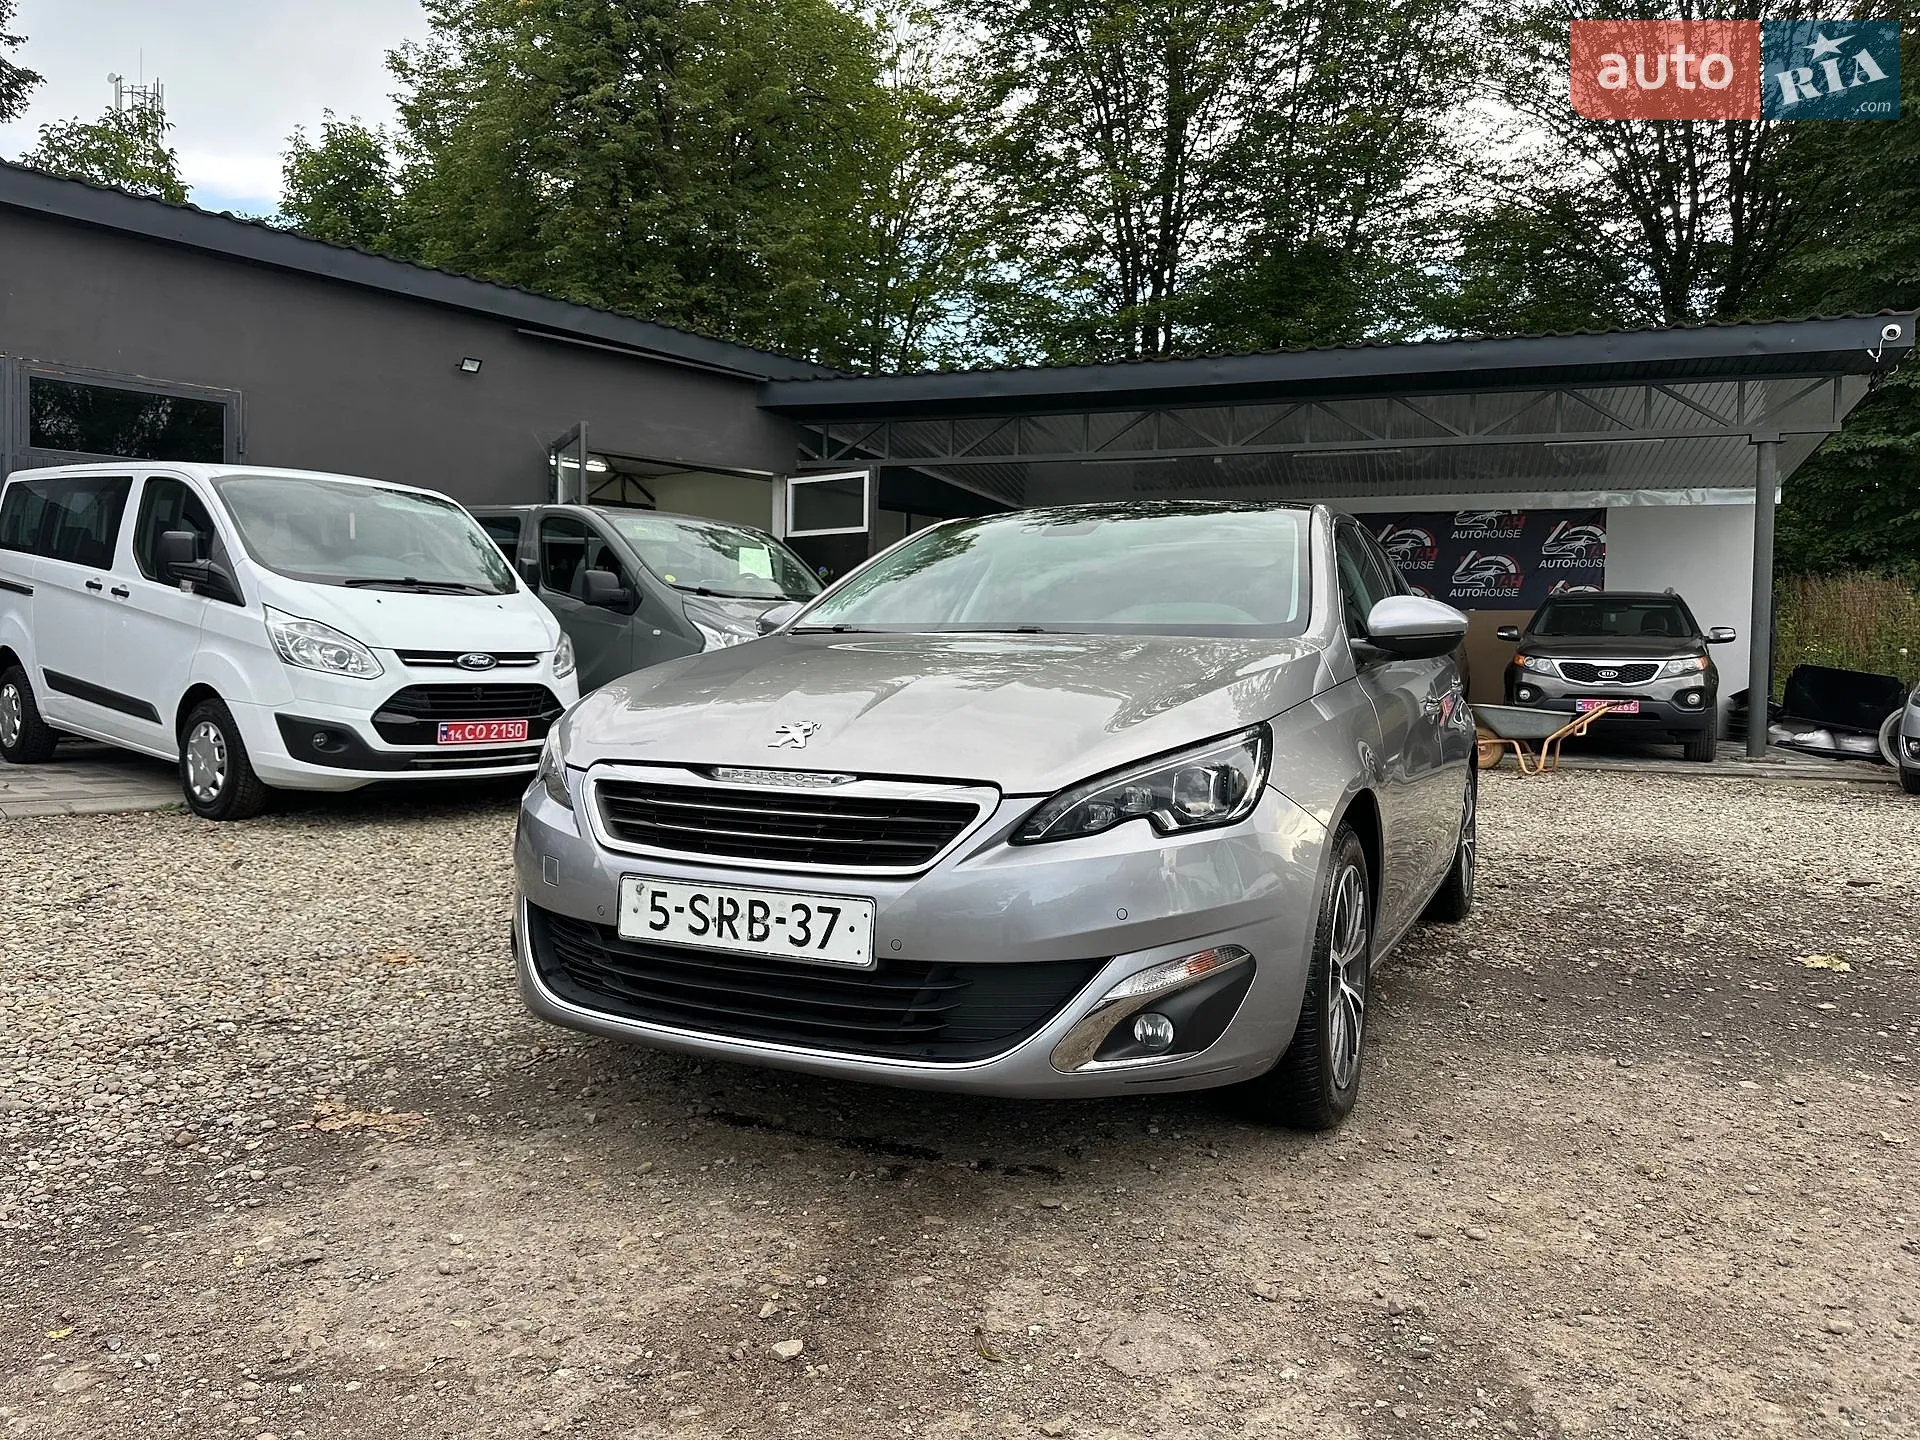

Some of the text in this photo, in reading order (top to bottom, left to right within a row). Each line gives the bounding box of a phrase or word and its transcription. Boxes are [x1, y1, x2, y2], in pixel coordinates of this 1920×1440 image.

[1450, 529, 1522, 539] AUTOHOUSE
[1448, 587, 1520, 598] AUTOHOUSE
[468, 654, 490, 665] Ford
[448, 729, 462, 740] 14
[465, 724, 487, 740] CO
[490, 723, 523, 739] 2150
[730, 769, 818, 782] PEUGEOT
[648, 889, 842, 950] 5-SRB-37
